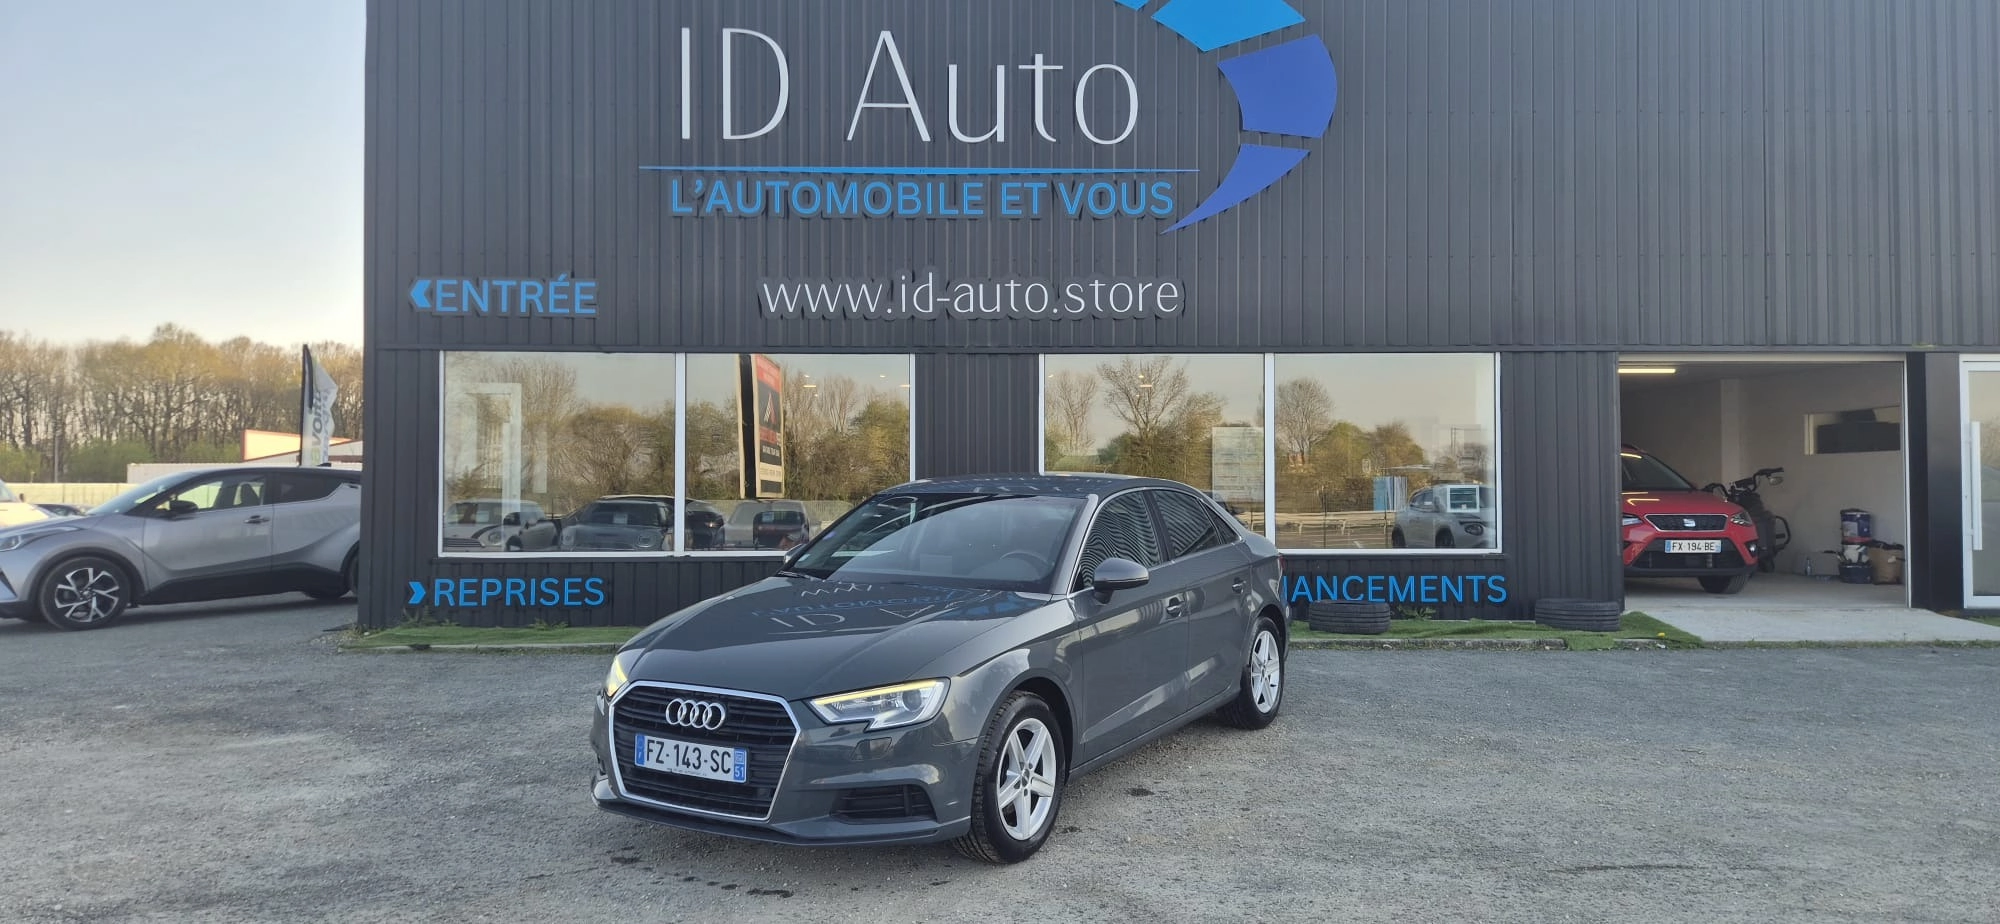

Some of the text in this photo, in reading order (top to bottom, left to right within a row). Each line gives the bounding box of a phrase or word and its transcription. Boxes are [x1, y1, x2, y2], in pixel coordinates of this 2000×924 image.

[681, 27, 1139, 145] ID Auto
[671, 179, 1175, 216] L’AUTOMOBILE ET VOUS
[435, 273, 597, 314] ENTRÉE
[762, 271, 1180, 315] www.id-auto.store
[434, 577, 605, 607] REPRISES
[1282, 575, 1508, 603] ANCEMENTS
[646, 739, 732, 775] FZ-143-SC
[734, 763, 745, 778] 51
